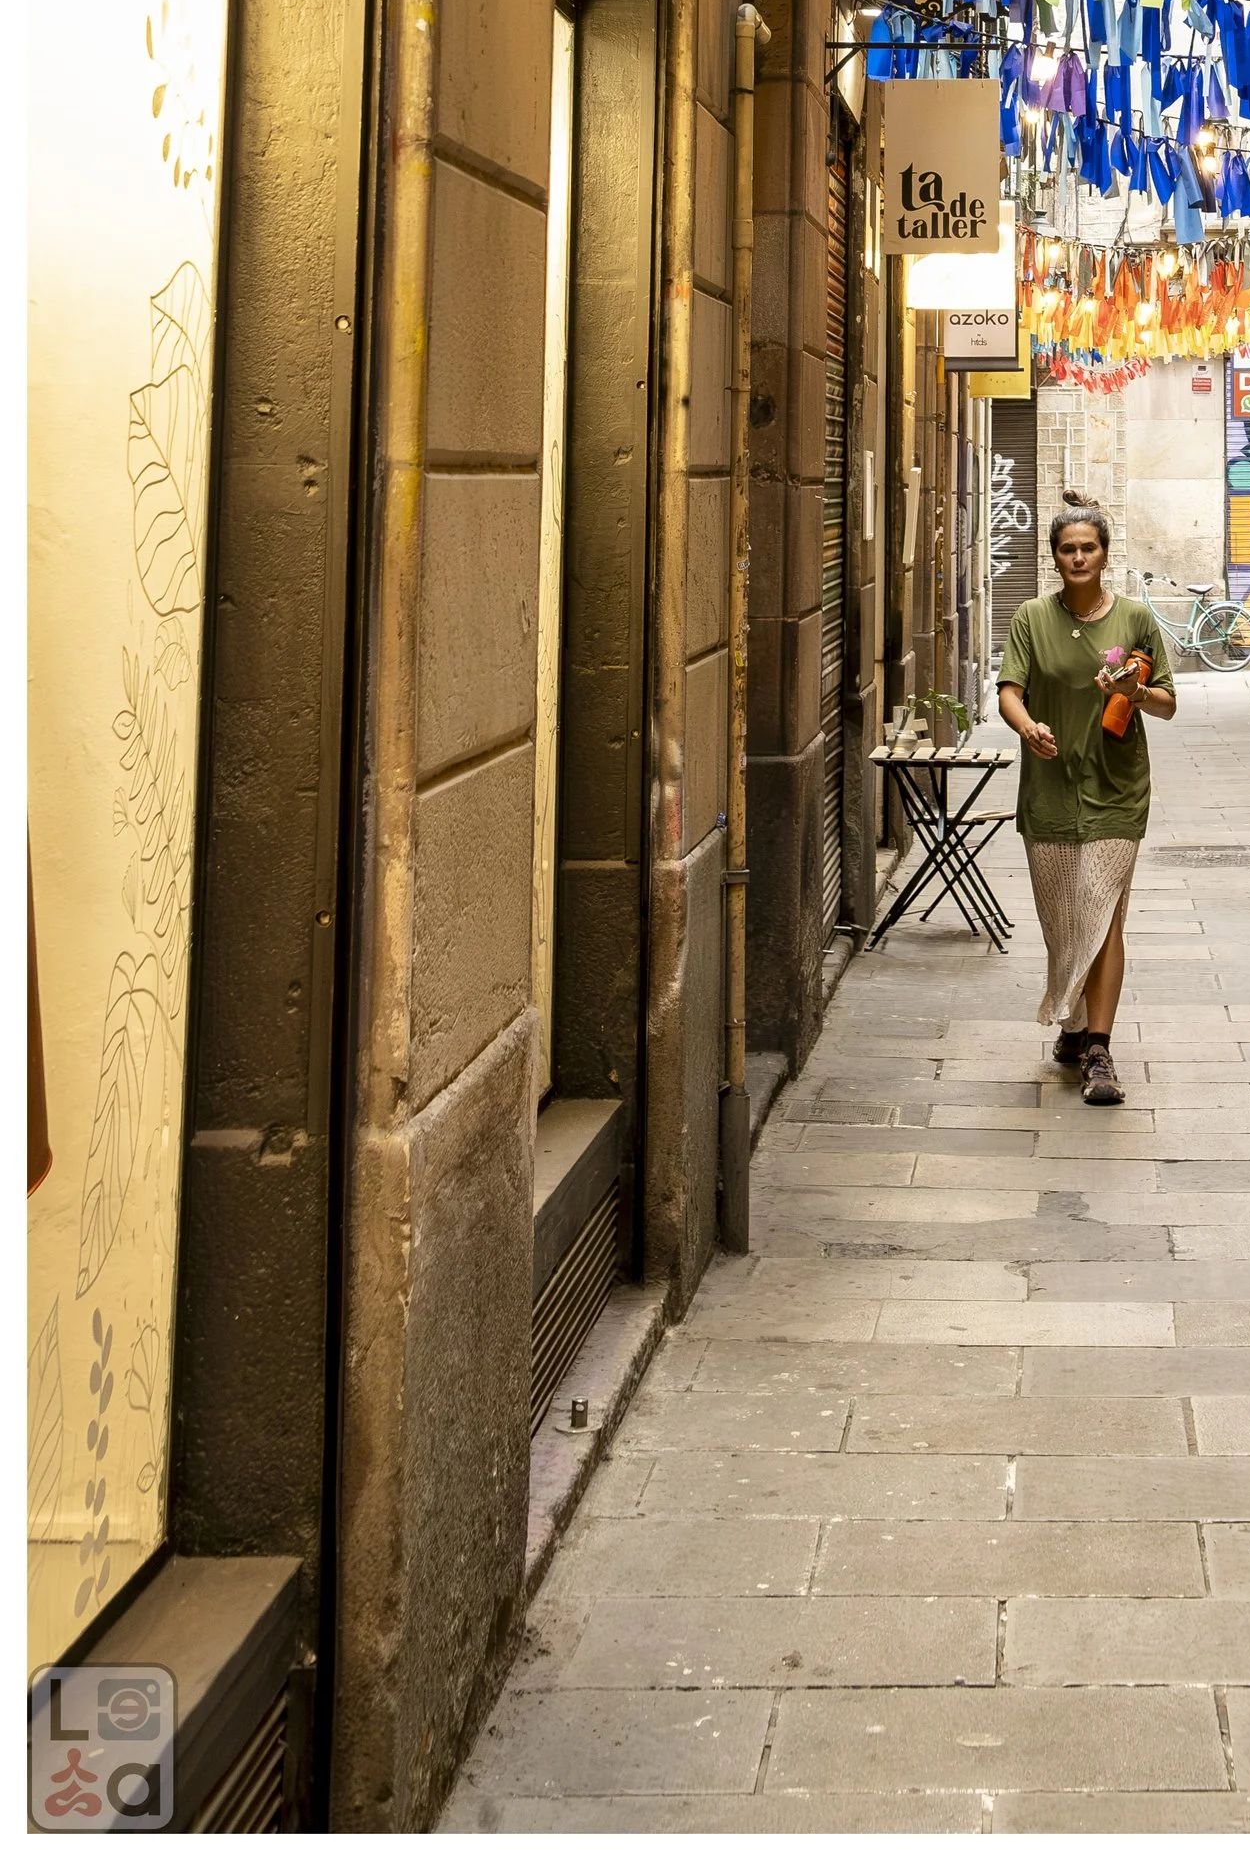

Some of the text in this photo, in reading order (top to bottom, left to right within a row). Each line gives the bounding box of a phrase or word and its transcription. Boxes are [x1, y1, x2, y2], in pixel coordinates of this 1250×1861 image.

[899, 162, 985, 218] ta de
[896, 212, 987, 239] taller
[949, 309, 1009, 326] azoko
